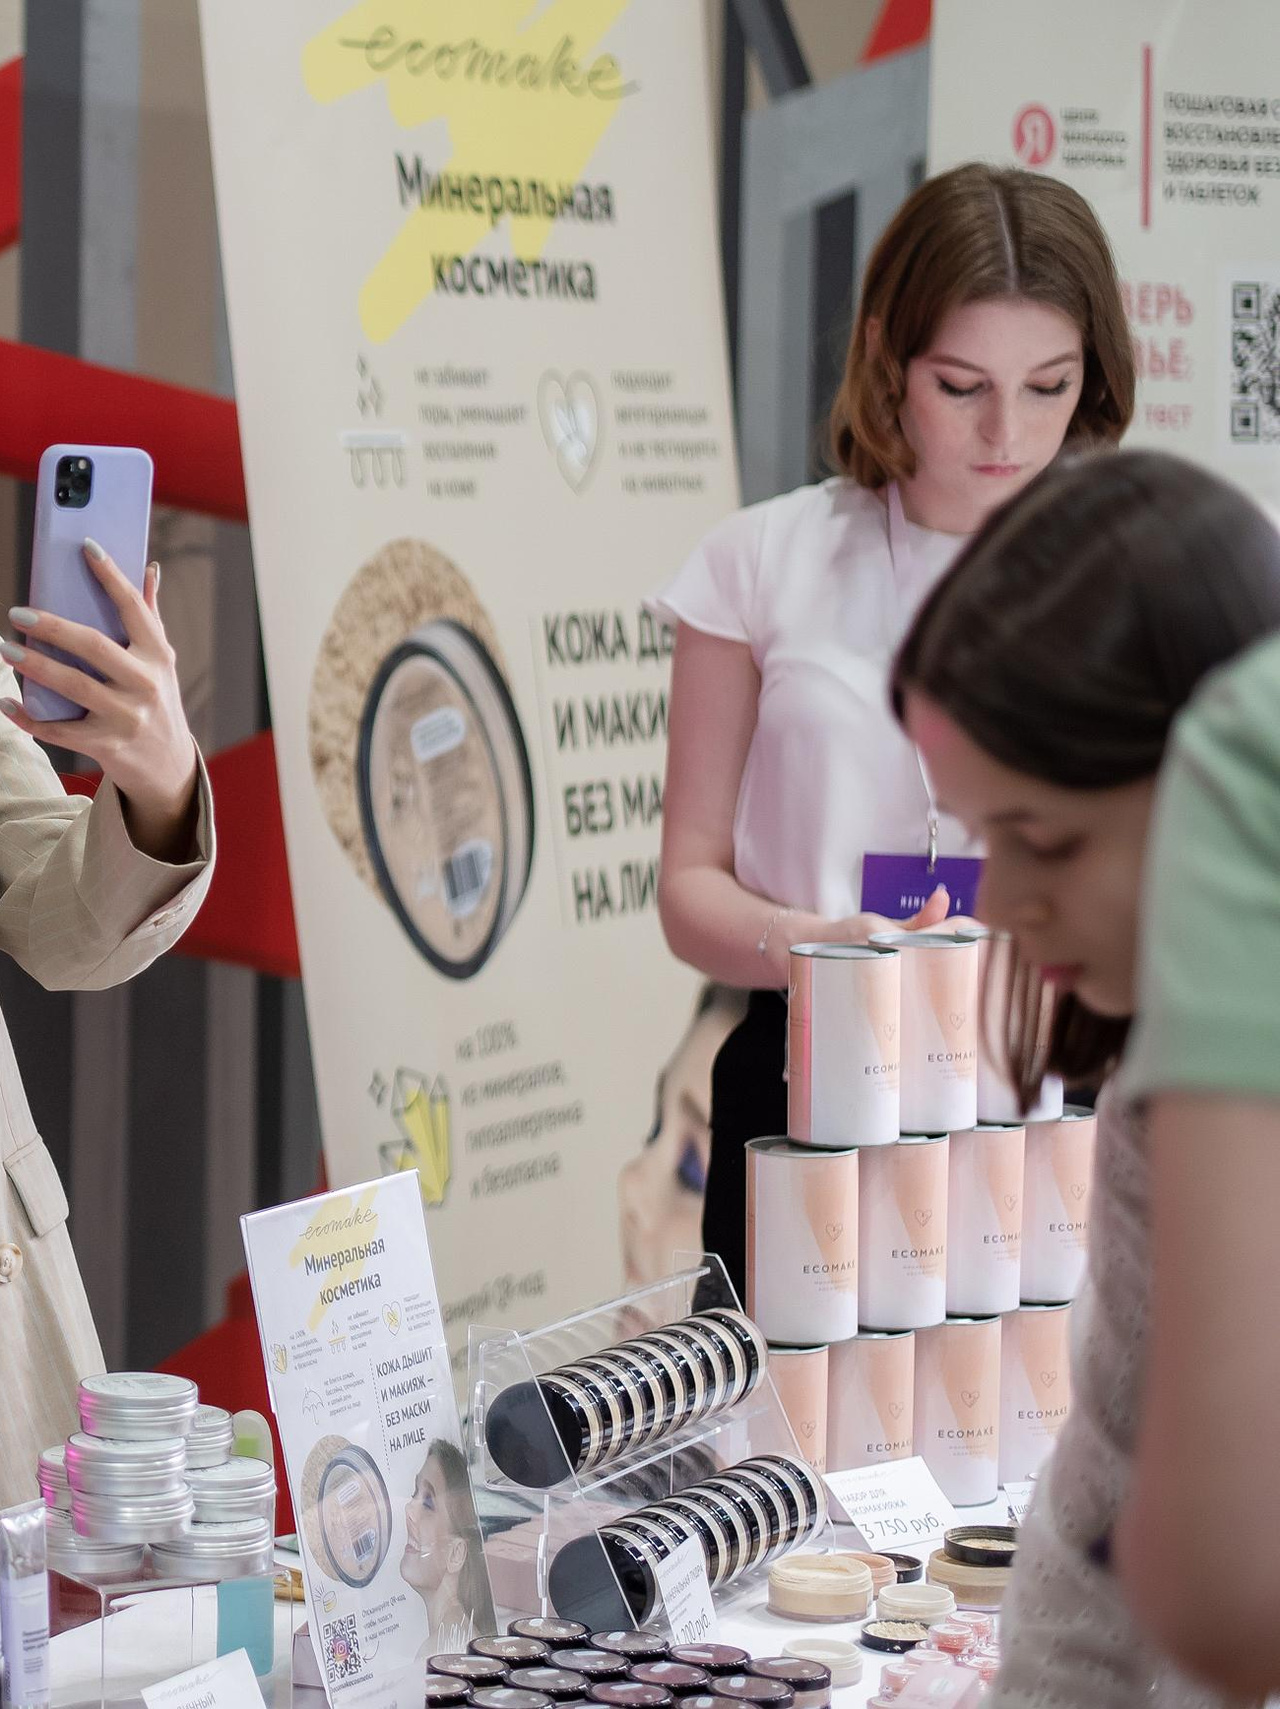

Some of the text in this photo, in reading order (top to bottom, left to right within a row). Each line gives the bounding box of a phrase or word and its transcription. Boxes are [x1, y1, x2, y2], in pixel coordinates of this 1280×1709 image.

[339, 24, 639, 100] ecomake
[395, 152, 617, 227] Минеральная
[431, 253, 598, 302] косметика
[543, 608, 629, 668] КОЖА
[553, 698, 577, 750] И
[563, 780, 614, 838] БЕЗ
[572, 867, 615, 923] НА
[298, 1207, 379, 1240] ecomake
[303, 1237, 386, 1277] Минеральная
[319, 1272, 382, 1306] косметика
[375, 1346, 434, 1379] КОЖА ДЫШИТ
[380, 1388, 389, 1403] И
[388, 1374, 427, 1400] МАКИЯЖ
[385, 1399, 432, 1428] БЕЗ МАСКИ
[389, 1427, 426, 1454] НА ЛИЦЕ
[937, 1425, 994, 1439] ECOMAKE
[860, 1511, 945, 1540] 3 750 руб.
[695, 1606, 712, 1642] руб.
